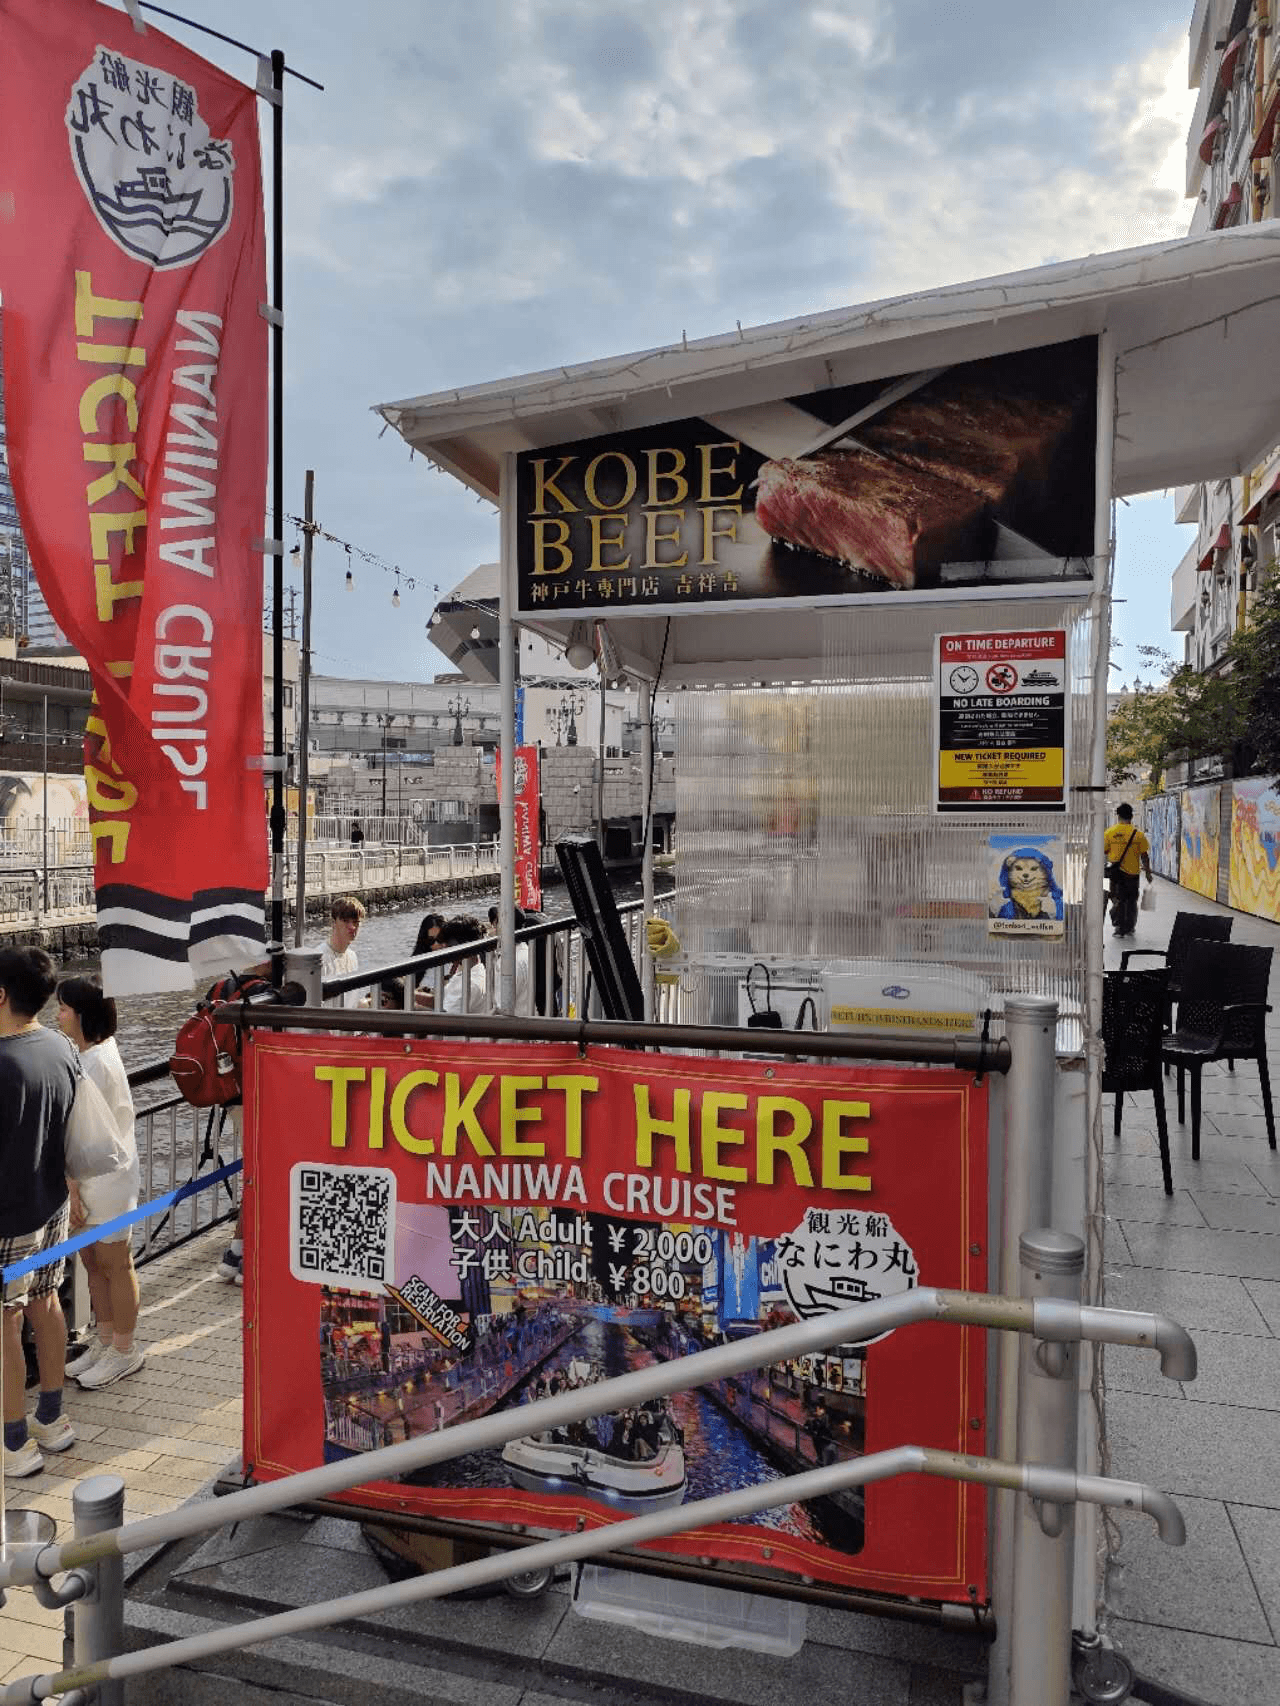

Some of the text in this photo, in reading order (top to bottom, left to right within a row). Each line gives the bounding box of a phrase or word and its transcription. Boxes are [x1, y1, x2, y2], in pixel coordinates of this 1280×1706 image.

[528, 441, 744, 515] KOBE
[527, 505, 742, 576] BEEF
[946, 637, 1055, 651] ON TIME DEPARTURE
[953, 696, 1050, 708] NO LATE BOARDING
[954, 752, 1046, 761] NEW TICKET REQUIRED
[315, 1066, 872, 1192] TICKET HERE
[426, 1161, 737, 1226] NANIWA CRUISE
[451, 1213, 511, 1243] 大人
[518, 1213, 594, 1248] Adult
[807, 1210, 889, 1238] 観光船
[450, 1247, 511, 1280] 子供
[517, 1250, 589, 1283] Child
[778, 1236, 916, 1276] なにわ丸
[400, 1285, 471, 1351] RESERVATION
[408, 1276, 462, 1328] SCAN FOR
